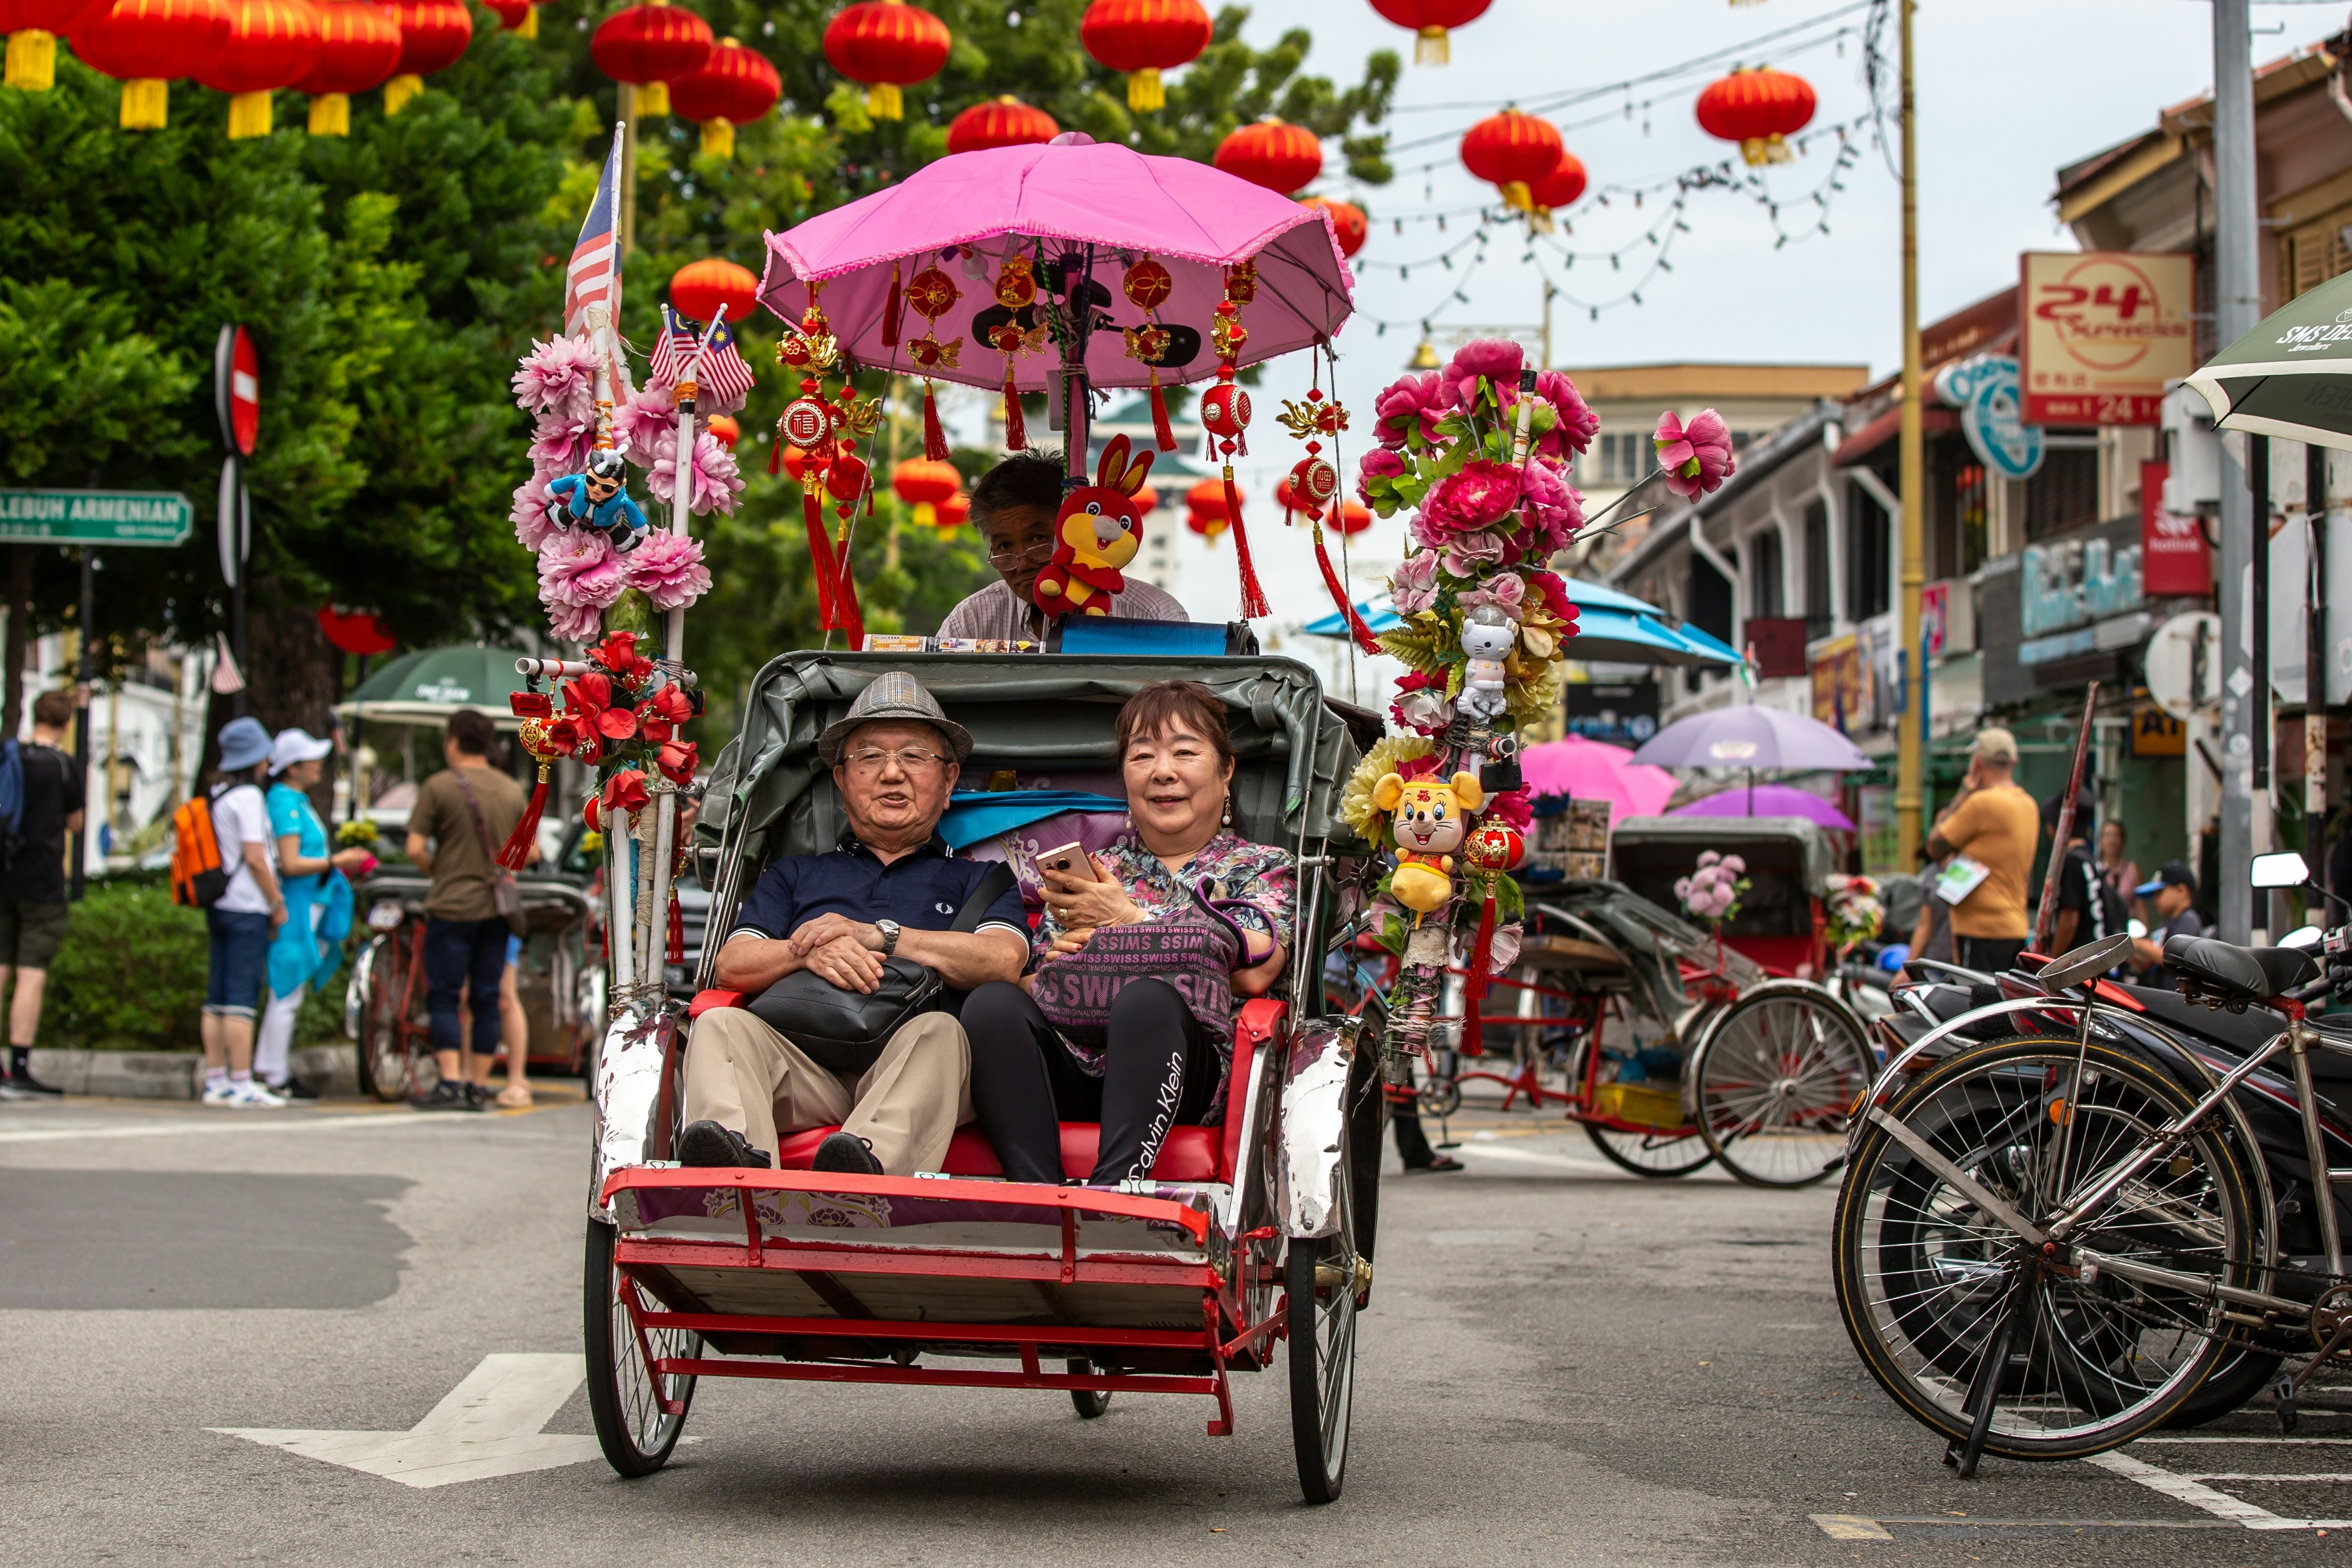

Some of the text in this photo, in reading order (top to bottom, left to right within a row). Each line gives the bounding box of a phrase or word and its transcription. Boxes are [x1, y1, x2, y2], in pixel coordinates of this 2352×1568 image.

[2035, 285, 2151, 320] 24
[2275, 324, 2352, 343] SMS DEE
[2288, 342, 2332, 352] Jewellers
[2098, 396, 2133, 421] 24
[793, 414, 814, 434] 福
[0, 497, 178, 522] LEBUH ARMENIAN
[1417, 790, 1431, 802] 福
[1103, 953, 1139, 963] SWISS
[1141, 953, 1178, 963] SWISS
[1039, 1003, 1061, 1014] RIGINAL
[1061, 1008, 1090, 1016] ORIGINAL
[1128, 1113, 1168, 1181] Calvin
[1157, 1051, 1182, 1113] Klein
